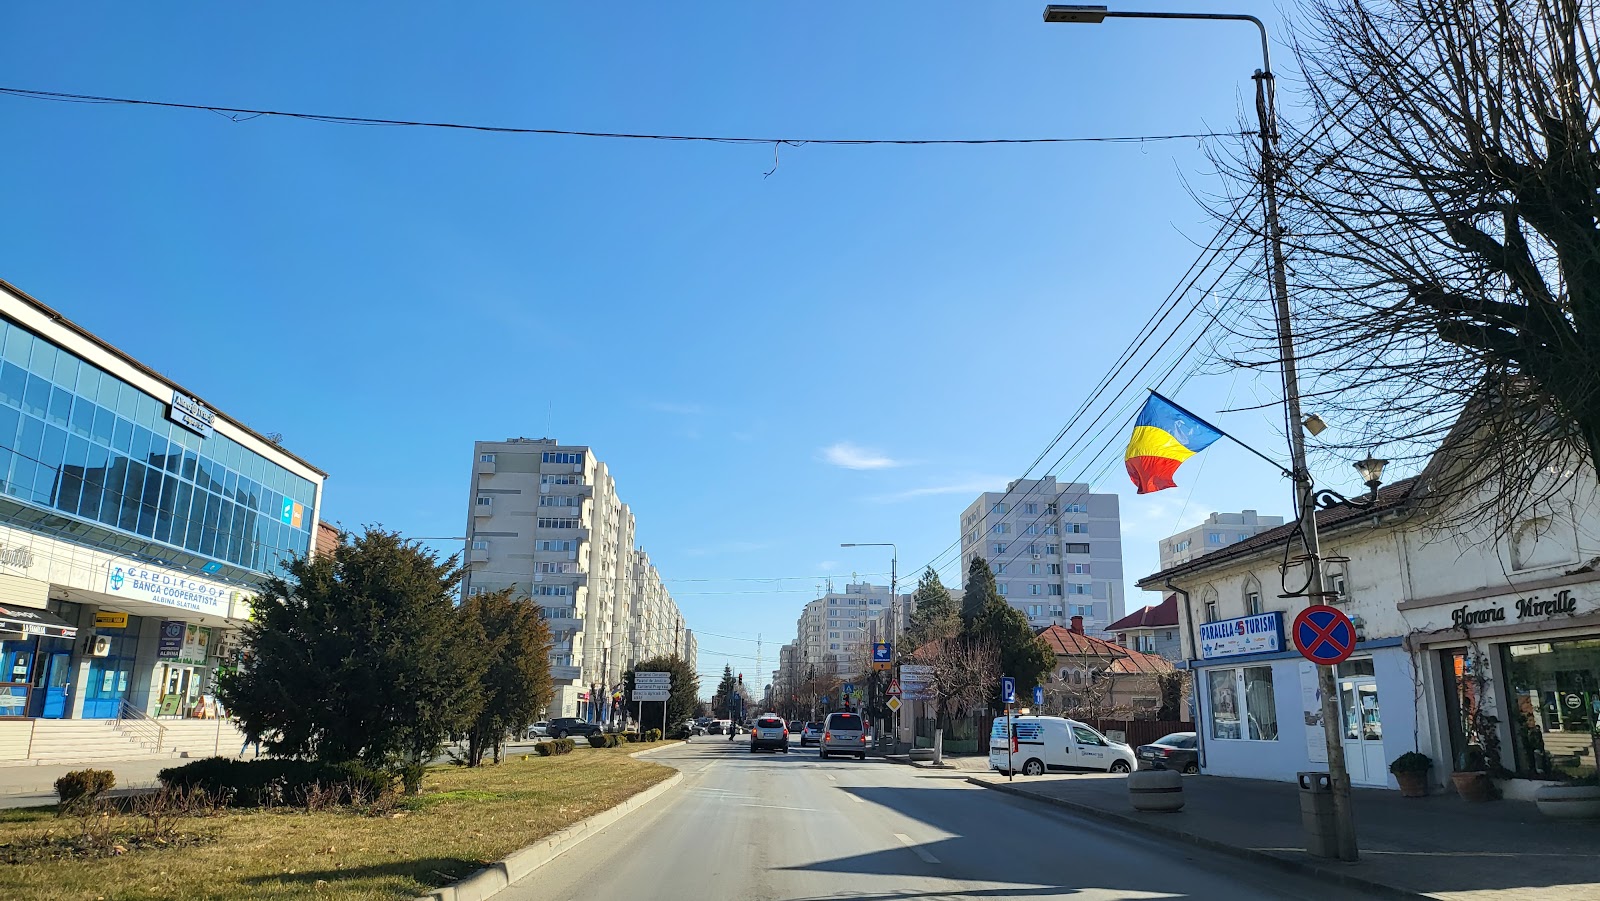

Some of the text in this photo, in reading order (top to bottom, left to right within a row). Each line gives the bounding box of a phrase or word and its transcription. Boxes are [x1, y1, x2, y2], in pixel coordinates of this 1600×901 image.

[128, 567, 225, 598] CREDITCOOP
[133, 579, 161, 595] BANCA
[152, 595, 200, 611] ALBINA SLATINA
[1516, 590, 1576, 619] Mireille
[1201, 615, 1276, 641] PARALELA 45 TURISM
[1005, 680, 1013, 699] P
